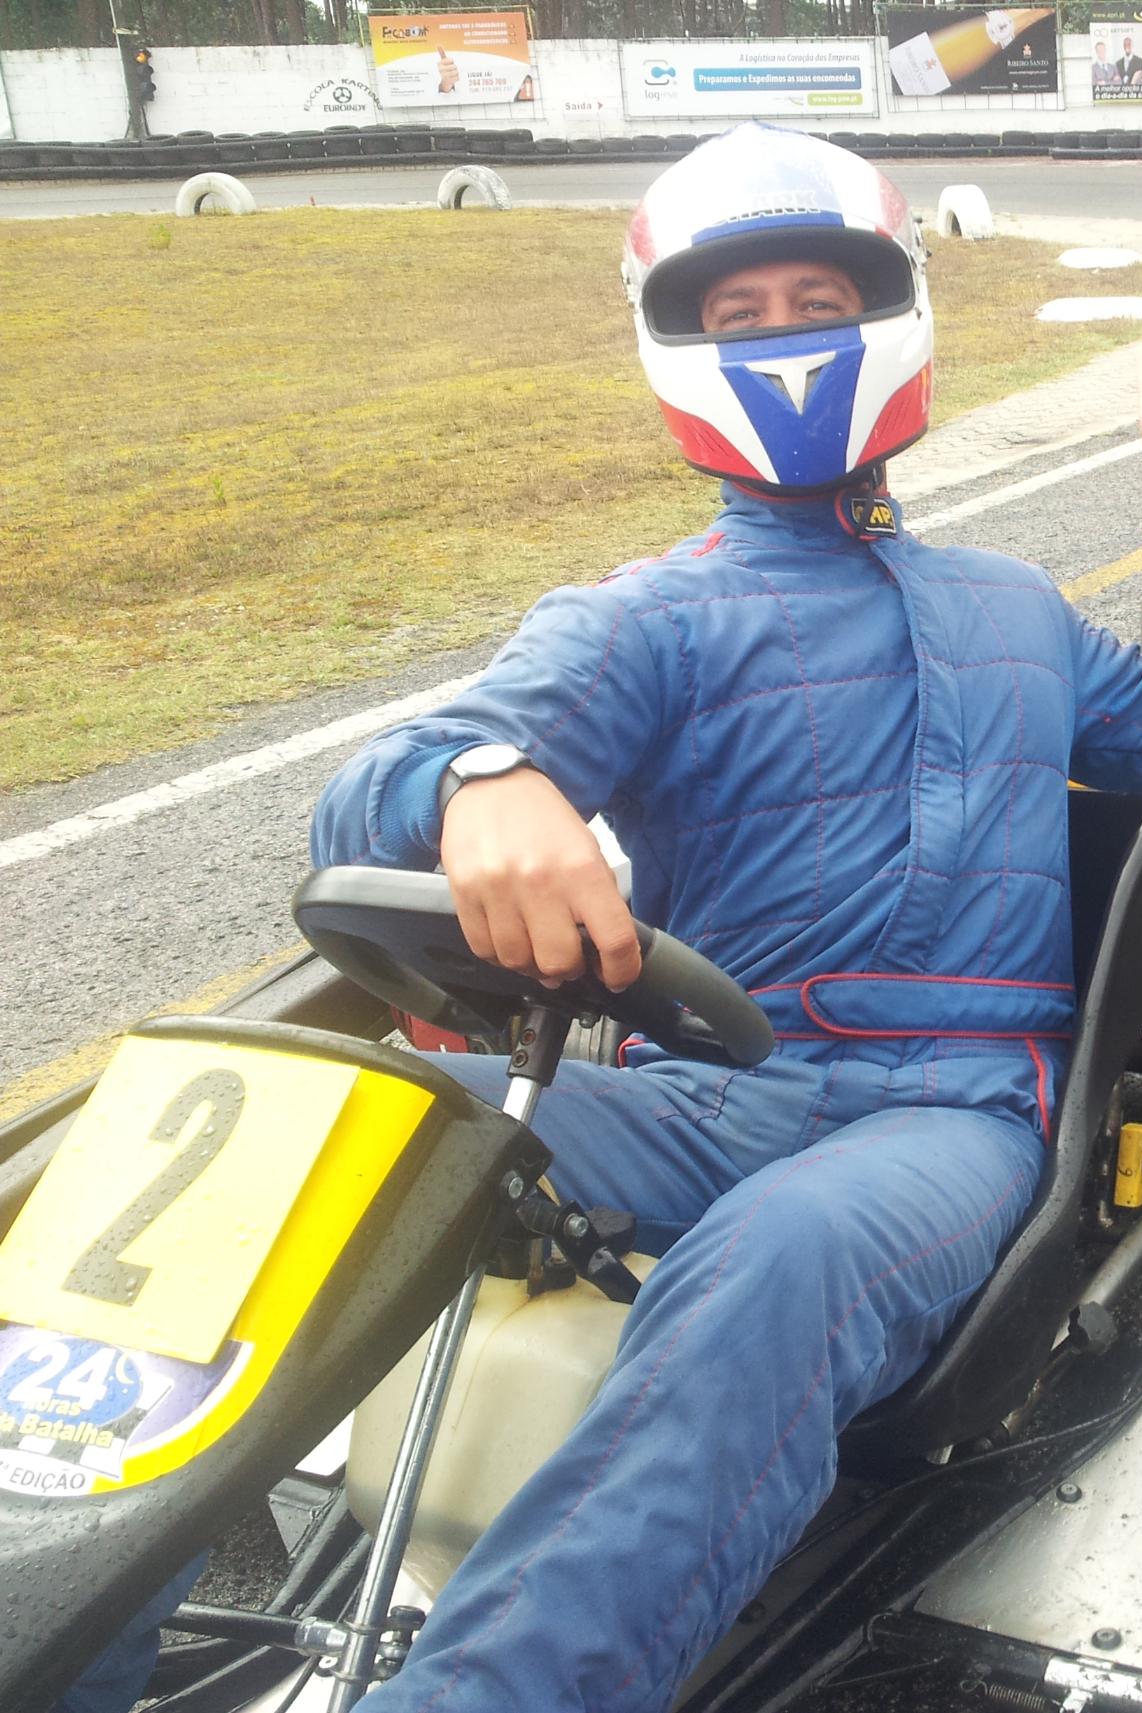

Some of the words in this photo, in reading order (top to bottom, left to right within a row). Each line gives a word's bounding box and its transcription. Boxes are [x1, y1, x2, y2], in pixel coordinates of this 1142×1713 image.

[698, 74, 742, 85] Preparamos
[748, 73, 786, 85] Expedimos
[813, 73, 856, 83] encomendas
[323, 104, 366, 113] EUROINDY
[60, 1067, 247, 1308] 2
[7, 1338, 118, 1411] 24
[18, 1413, 114, 1448] Batalha
[8, 1466, 86, 1494] EDIÇÃO
